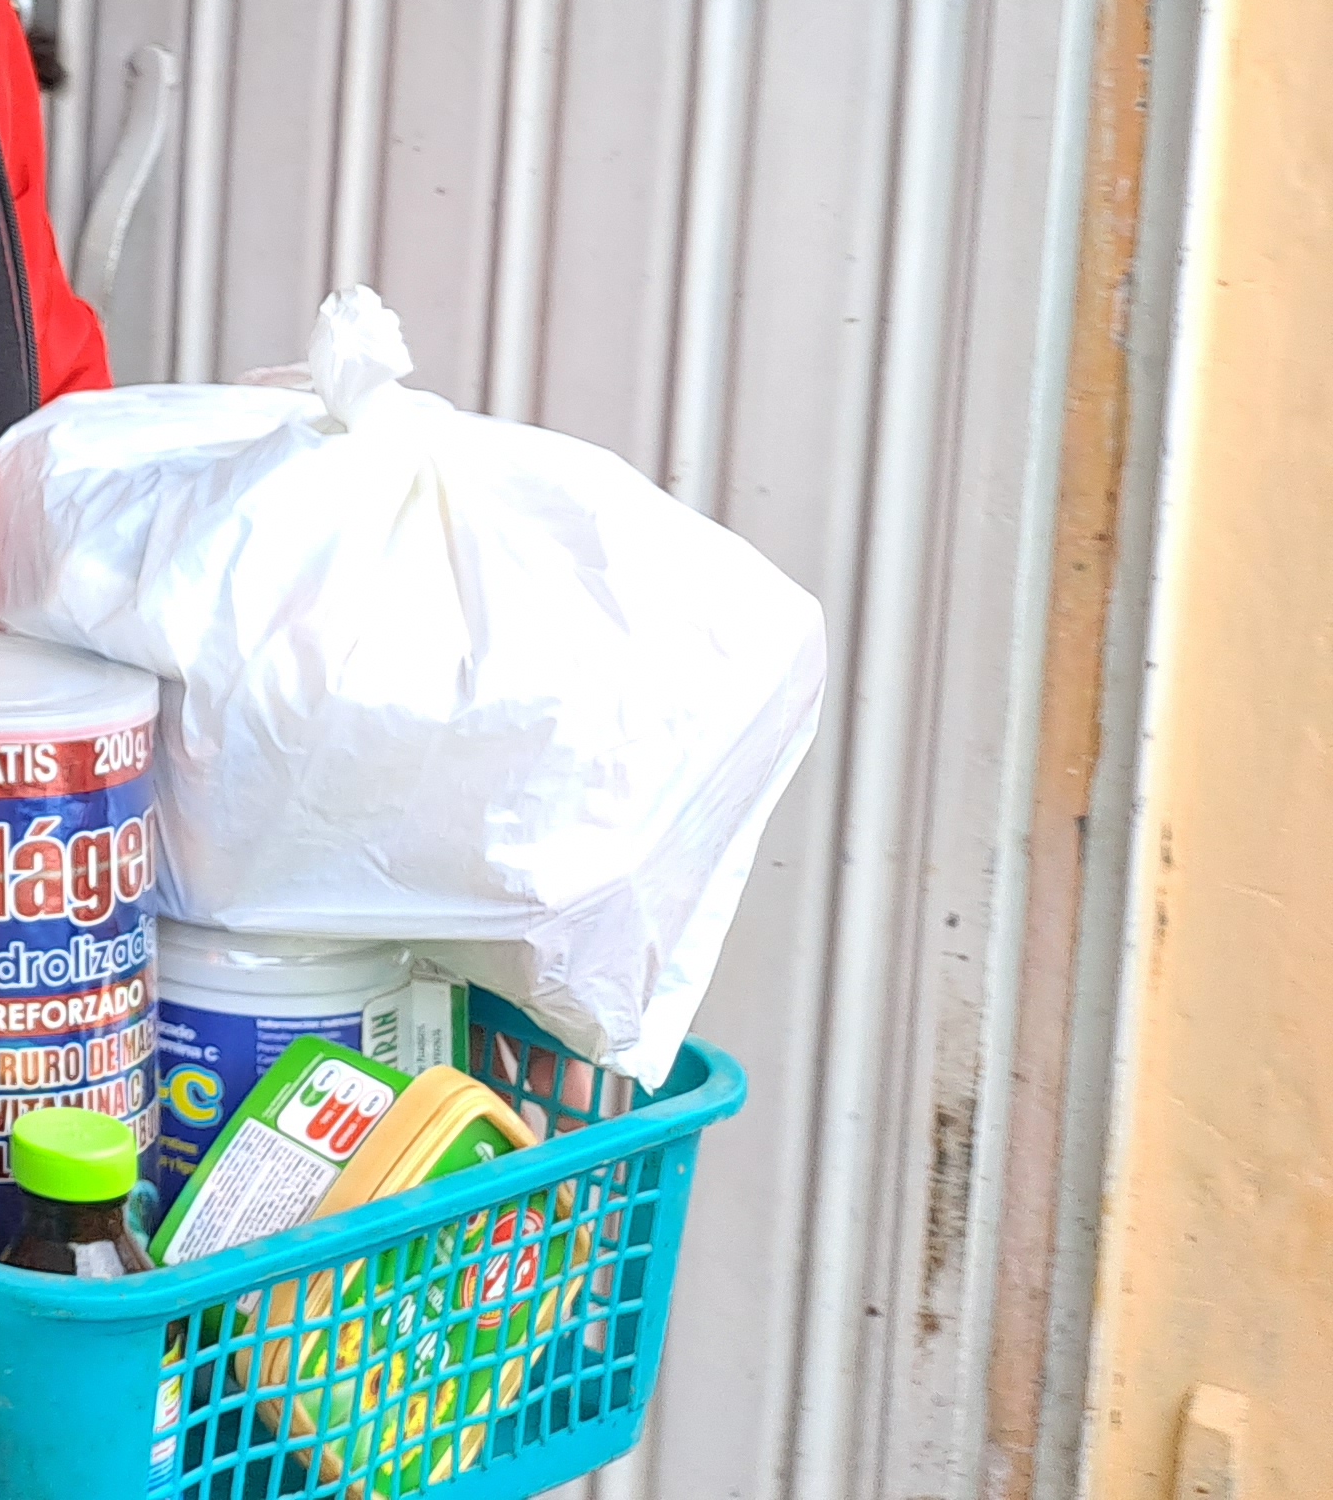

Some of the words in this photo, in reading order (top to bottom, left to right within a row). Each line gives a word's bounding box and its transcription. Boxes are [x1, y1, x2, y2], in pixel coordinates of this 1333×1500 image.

[93, 729, 134, 776] 200
[86, 1033, 119, 1082] DE
[128, 1069, 144, 1110] C
